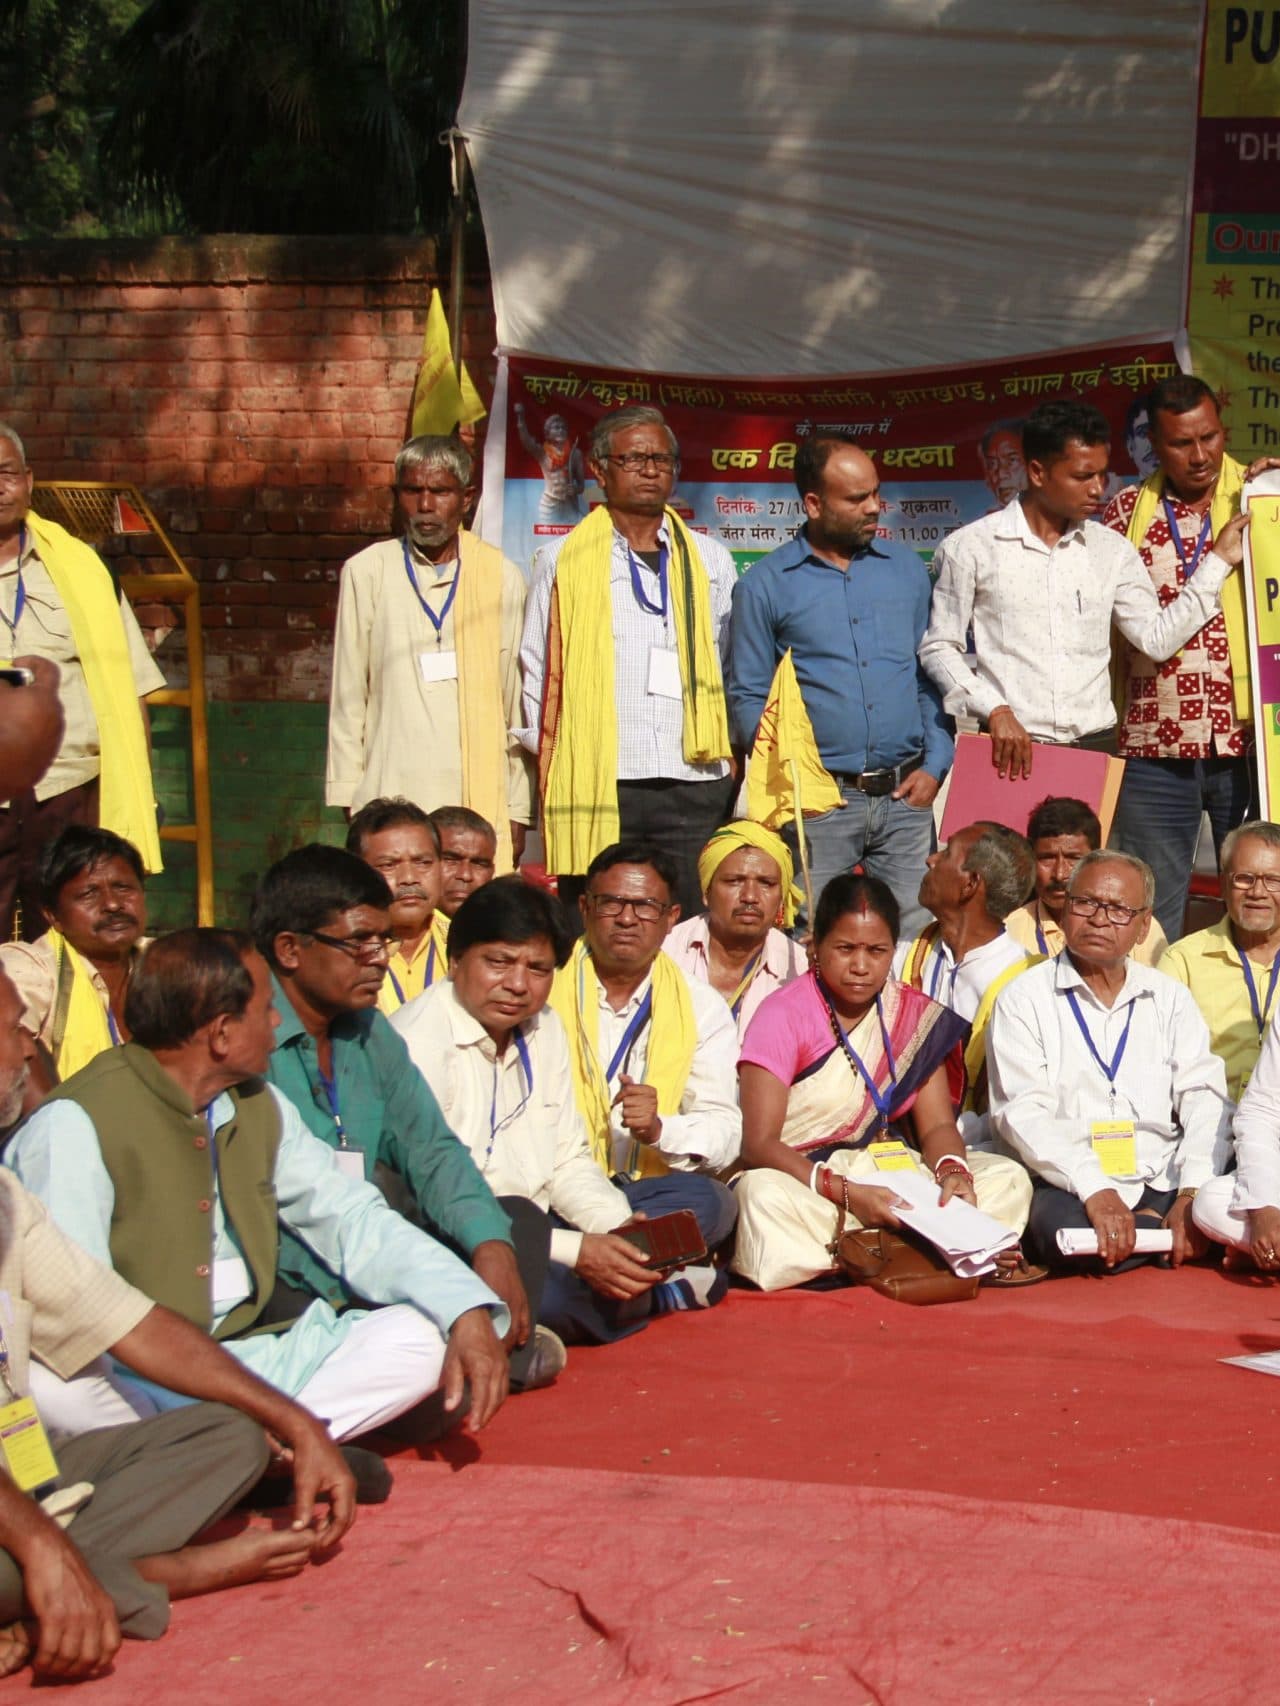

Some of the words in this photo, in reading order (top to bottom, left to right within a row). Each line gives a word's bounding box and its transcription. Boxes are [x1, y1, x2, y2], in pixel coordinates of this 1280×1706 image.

[712, 449, 762, 470] एक
[882, 445, 955, 468] धरना
[719, 525, 746, 540] जंतर
[900, 527, 938, 541] 11.00
